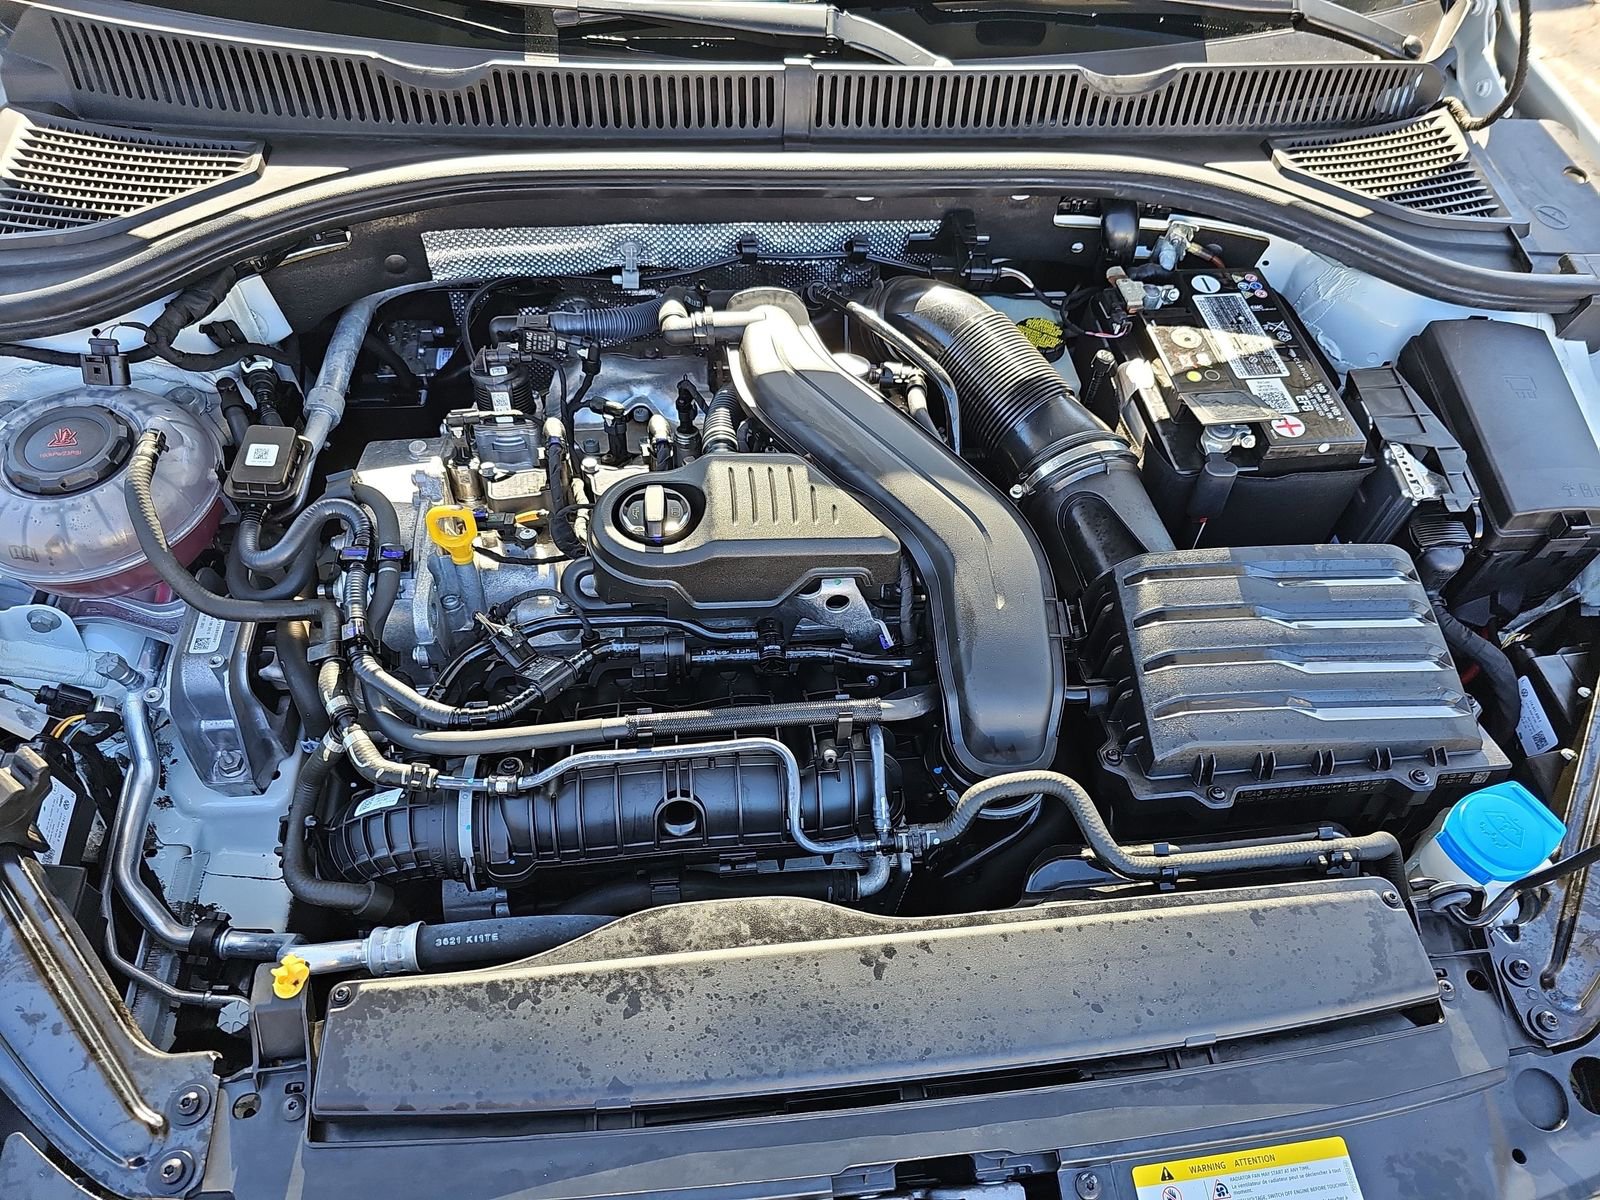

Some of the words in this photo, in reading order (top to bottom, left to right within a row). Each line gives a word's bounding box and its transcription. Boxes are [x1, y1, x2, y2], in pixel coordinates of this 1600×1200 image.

[525, 331, 533, 341] AG
[1293, 357, 1311, 380] CLARIOS
[1295, 395, 1314, 411] EFB
[435, 936, 461, 947] 3621
[1188, 1161, 1227, 1174] WARNING
[1234, 1154, 1276, 1167] ATTENTION
[1230, 1174, 1251, 1182] RADIATOR
[1238, 1180, 1261, 1189] ventilateur
[1305, 1170, 1328, 1178] déclencher
[1267, 1191, 1285, 1199] SWITCH
[1293, 1187, 1310, 1195] ENGINE
[1327, 1181, 1349, 1189] TOUCHING
